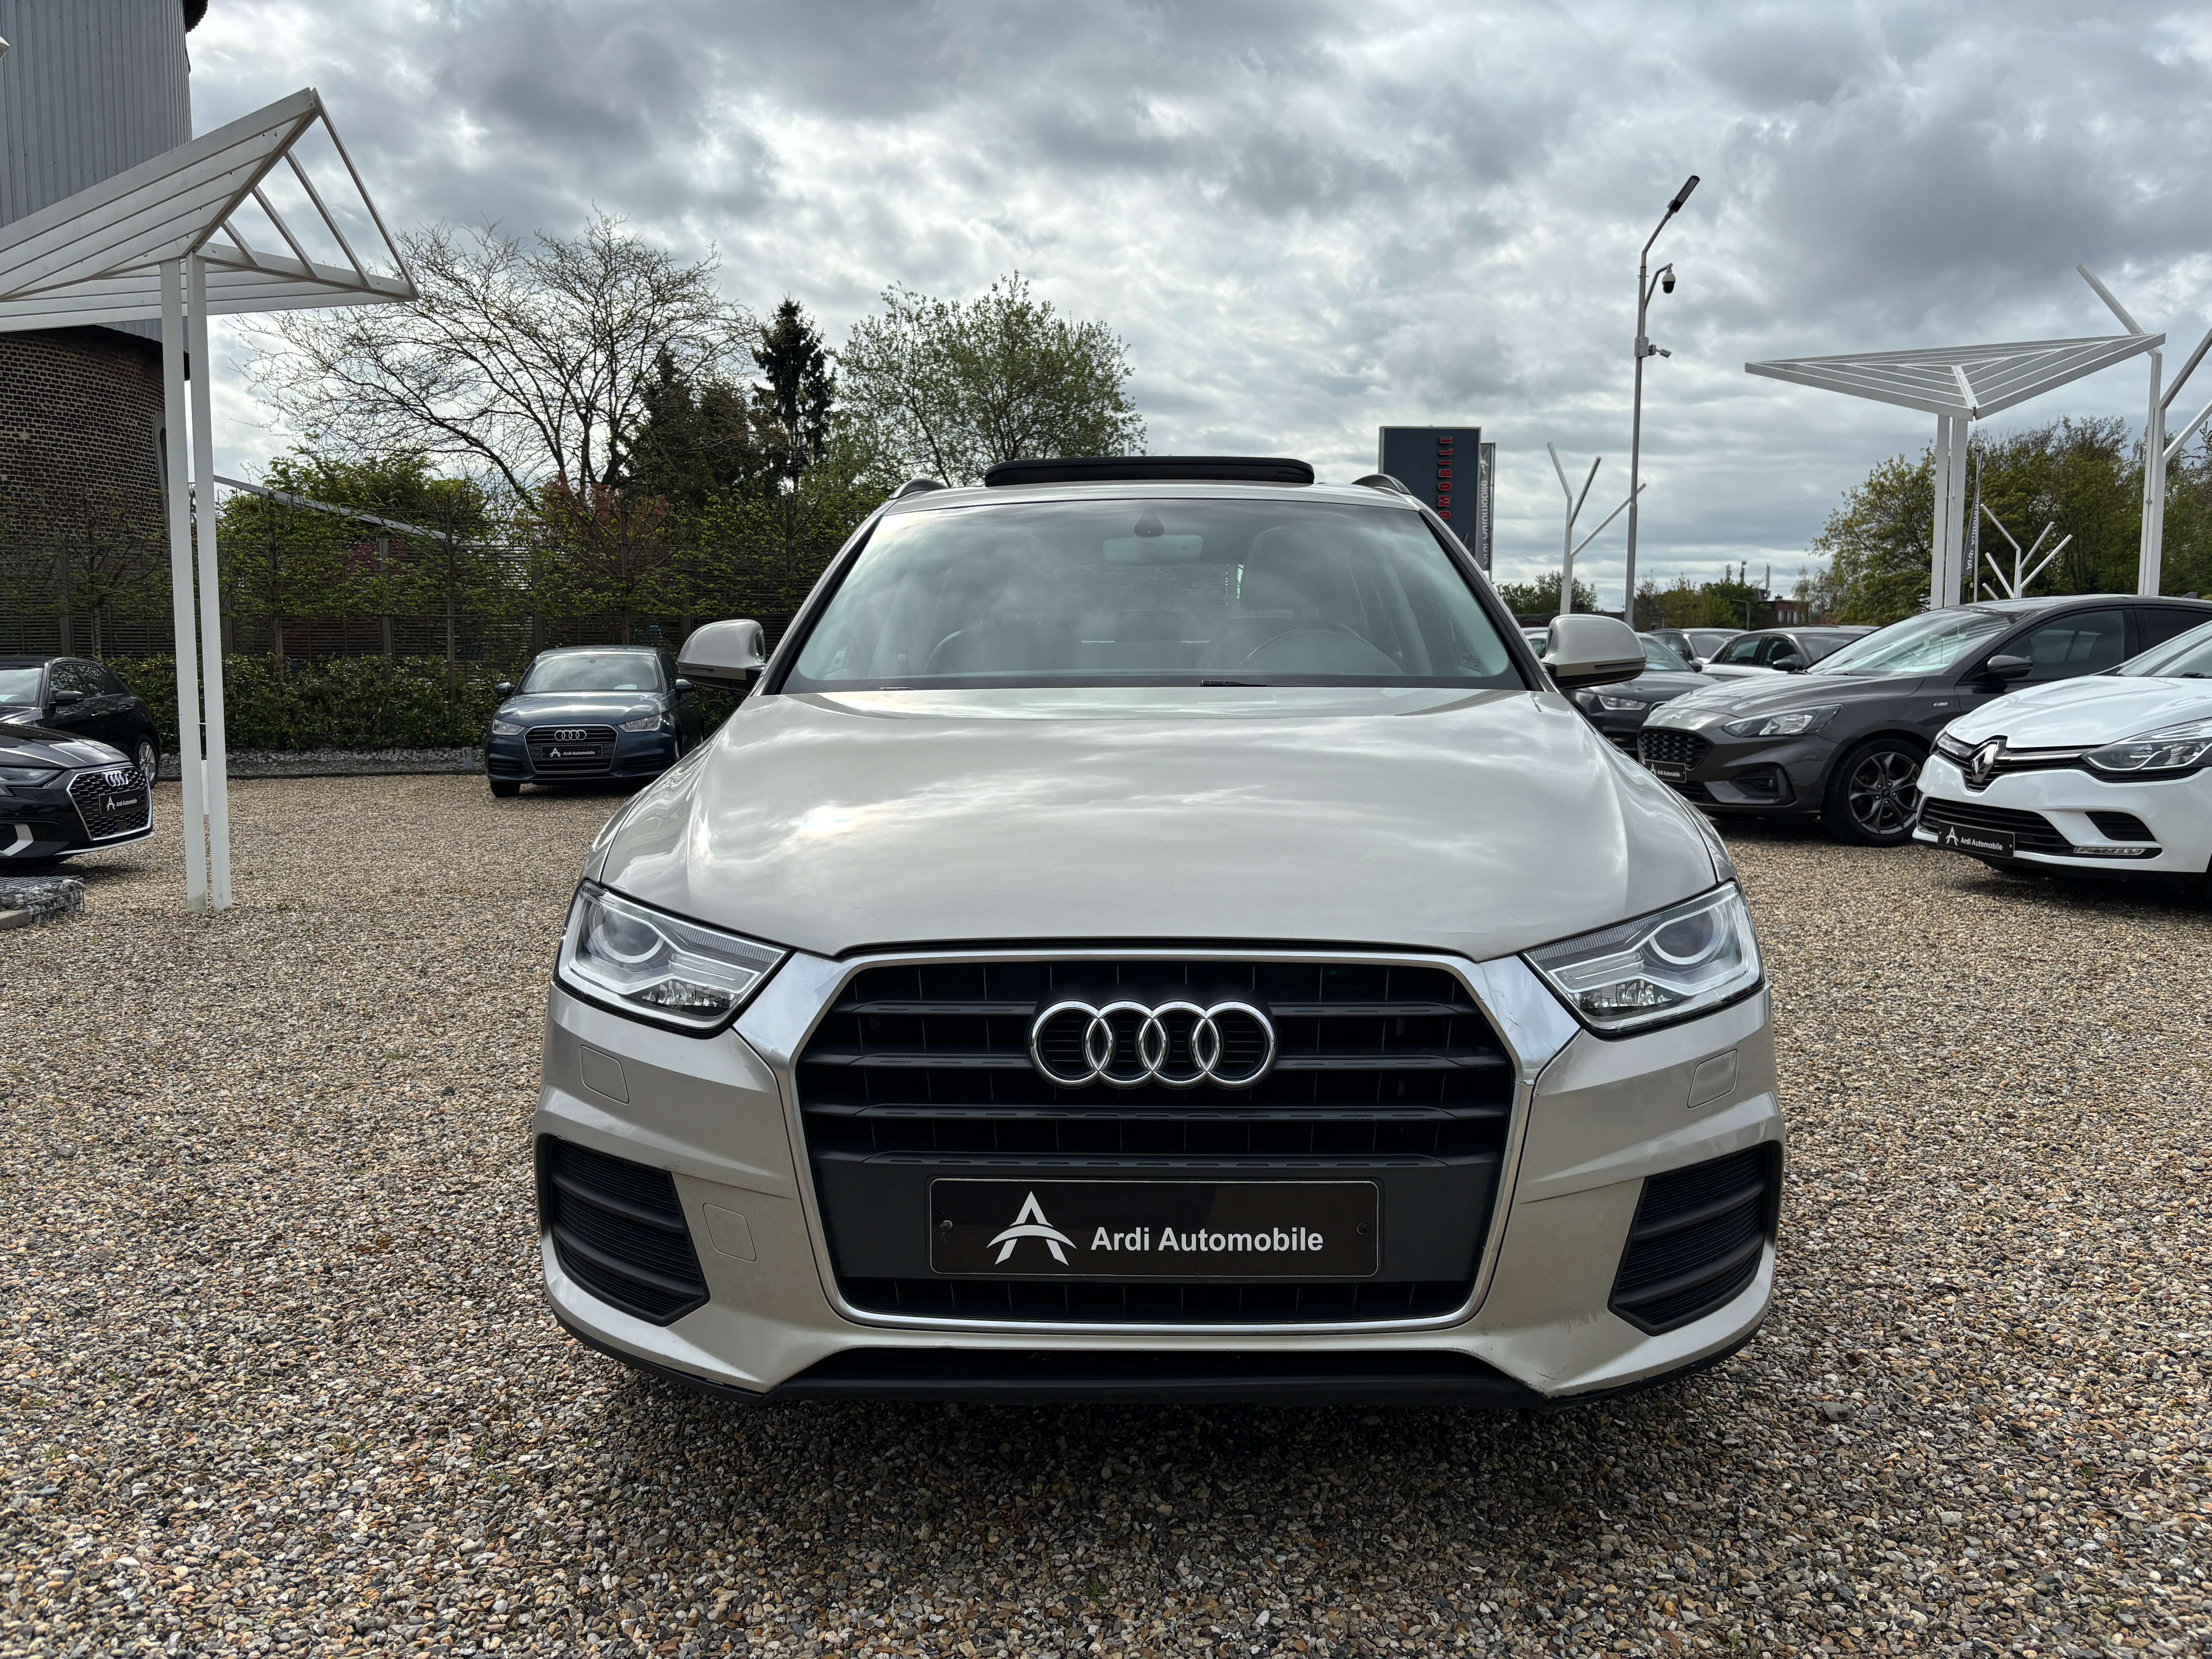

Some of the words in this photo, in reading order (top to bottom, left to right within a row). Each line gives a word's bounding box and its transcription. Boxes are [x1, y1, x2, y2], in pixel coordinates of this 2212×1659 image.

[1961, 836, 1971, 845] Ardi
[1972, 838, 2003, 850] Automobile
[1091, 1227, 1149, 1250] Ardi
[1158, 1227, 1323, 1251] Automobile
